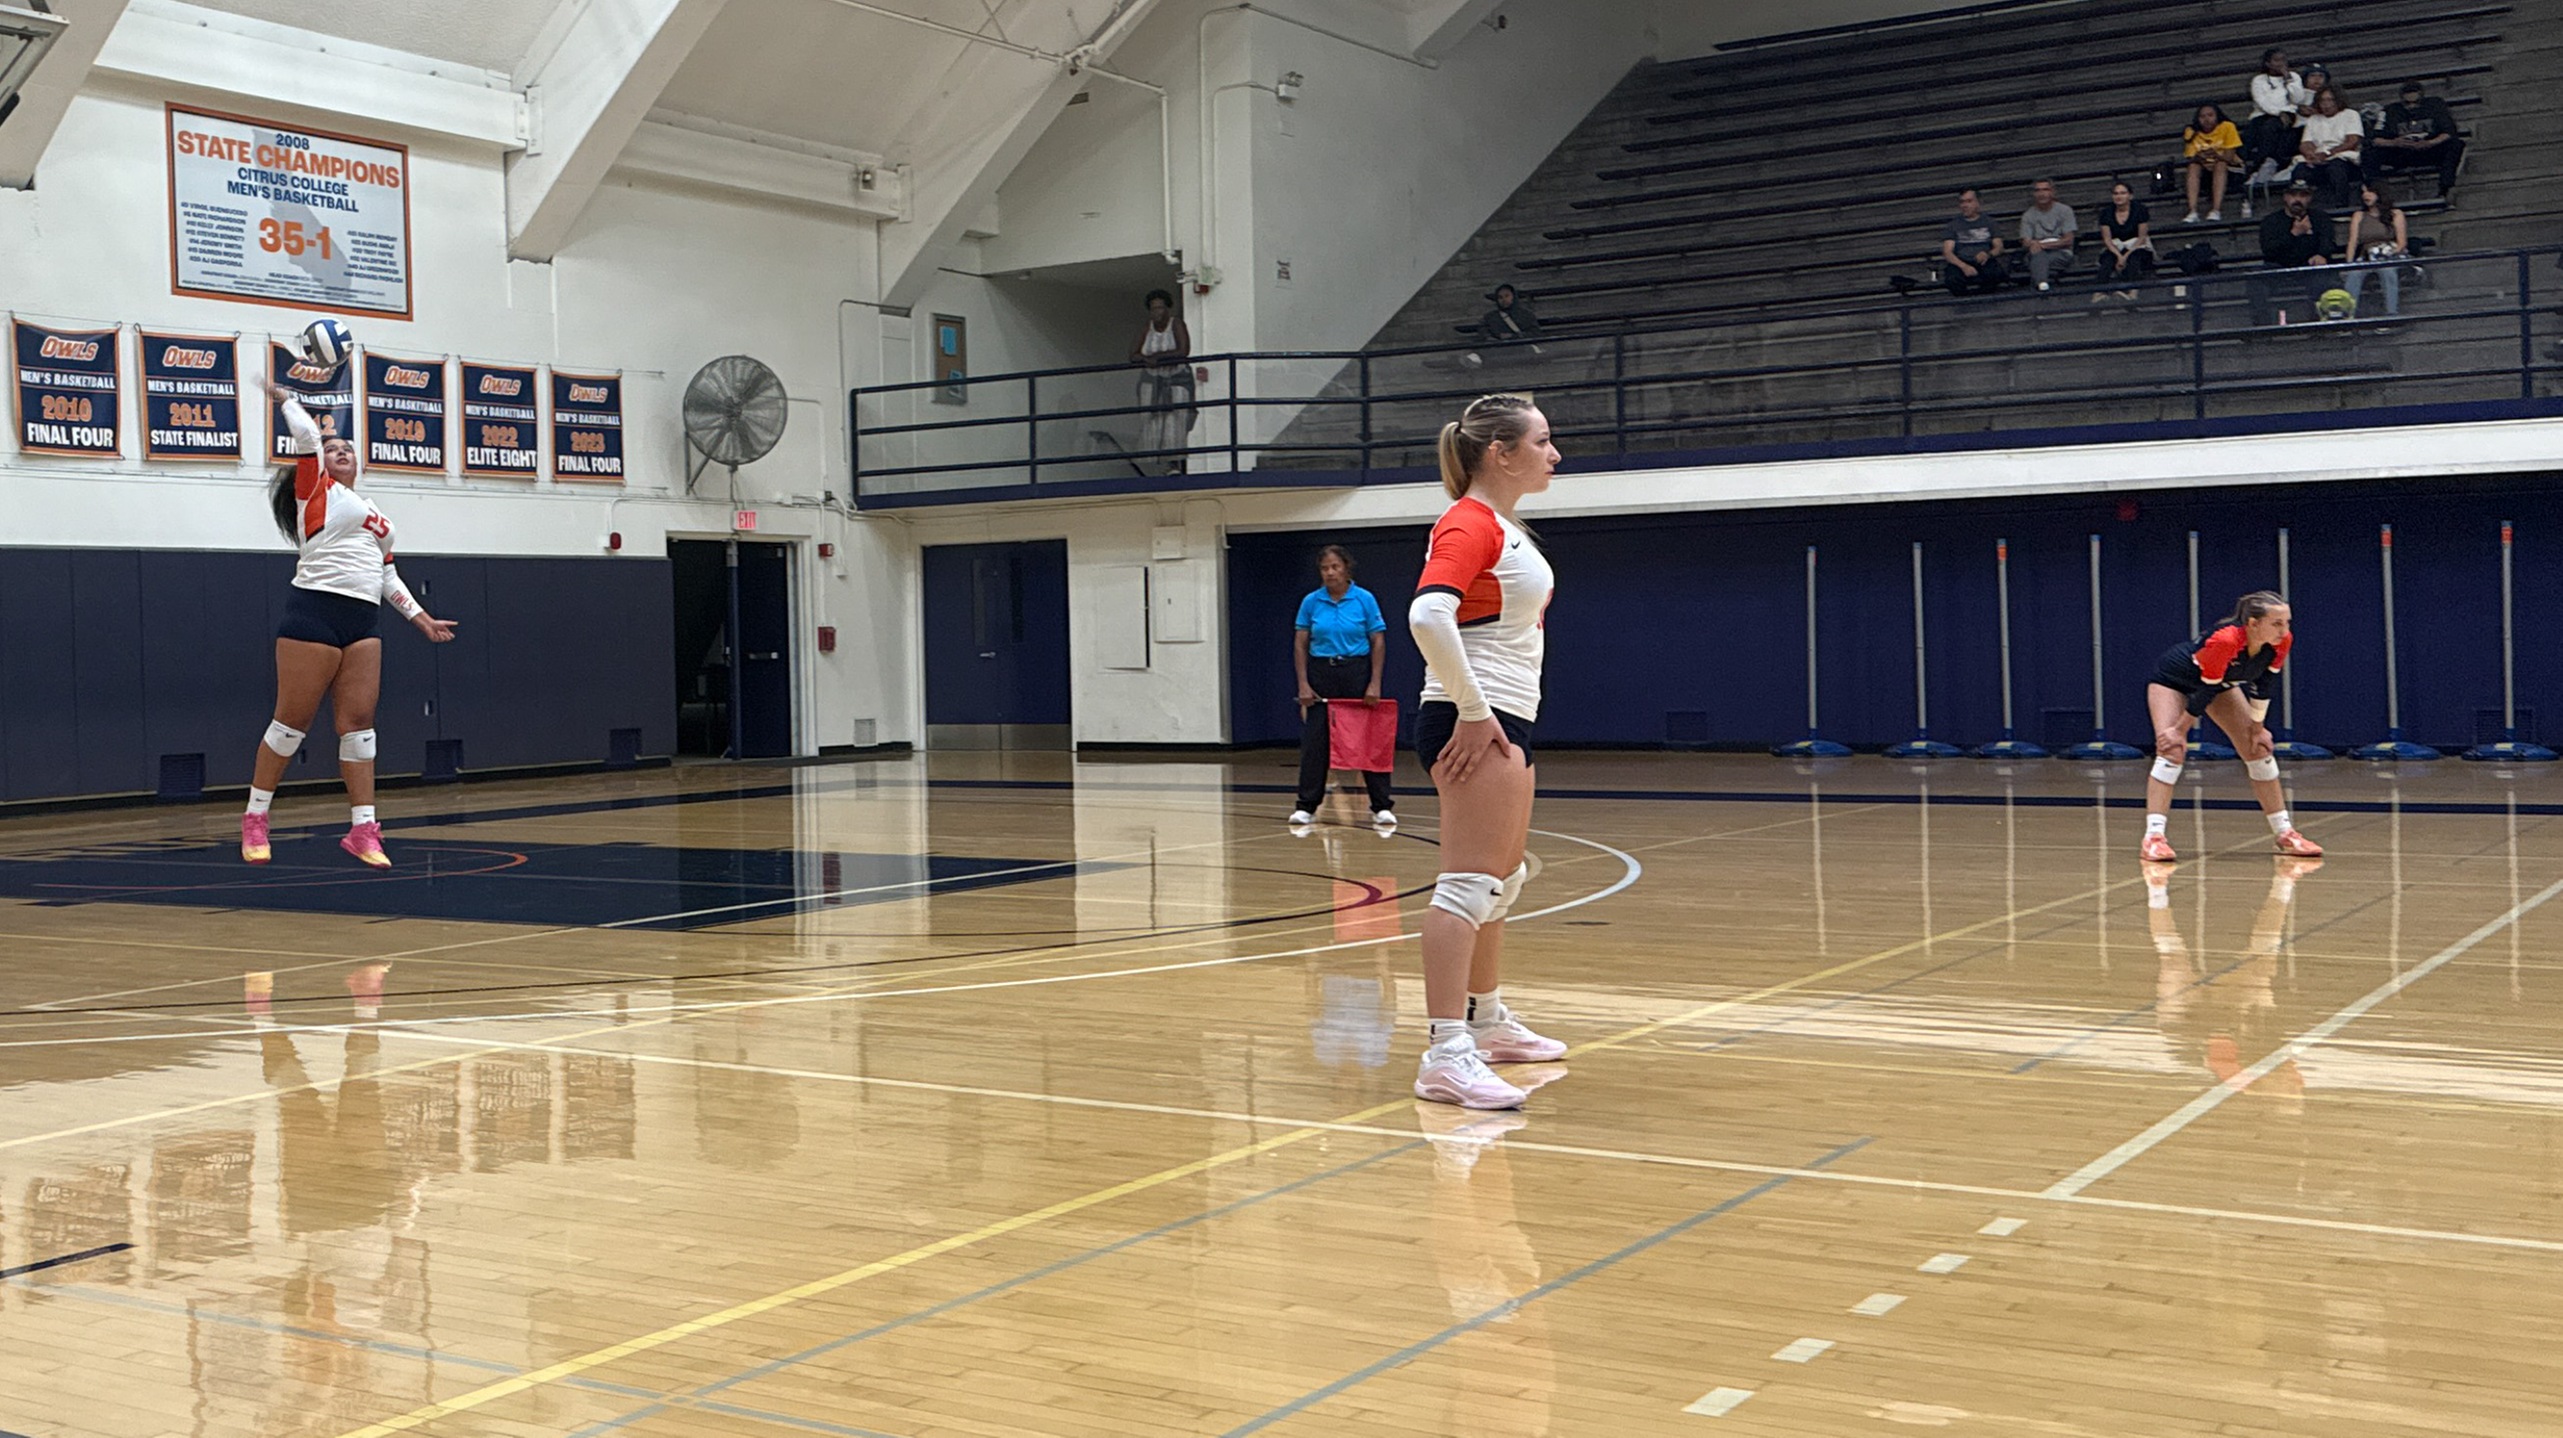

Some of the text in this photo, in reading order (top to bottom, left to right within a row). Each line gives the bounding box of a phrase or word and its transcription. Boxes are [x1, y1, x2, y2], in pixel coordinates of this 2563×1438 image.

[275, 133, 310, 150] 2008
[177, 130, 400, 188] STATE CHAMPIONS
[237, 167, 349, 197] CITRUS COLLEGE
[227, 181, 271, 200] MEN'S
[273, 188, 359, 213] BASKETBALL
[259, 217, 331, 260] 35-1
[40, 336, 99, 361] OWLS
[162, 346, 217, 369] OWLS
[20, 369, 115, 389] MEN'S BASKETBALL
[147, 379, 235, 395] MEN'S BASKETBALL
[384, 366, 430, 388] OWLS
[479, 374, 522, 396] OWLS
[569, 383, 609, 403] OWLS
[41, 395, 92, 422] 2010
[169, 402, 216, 427] 2011
[368, 396, 443, 413] MEN'S BASKETBALL
[466, 405, 535, 419] MEN'S BASKETBALL
[555, 412, 620, 425] MEN'S BASKETBALL
[27, 422, 114, 447] FINAL FOUR
[150, 429, 238, 447] STATE FINALIST
[482, 425, 519, 448] 2022
[371, 442, 441, 465] FINAL FOUR
[467, 447, 537, 467] ELITE EIGHT
[558, 455, 621, 473] FINAL FOUR
[361, 507, 391, 539] 25
[738, 511, 756, 529] EXIT
